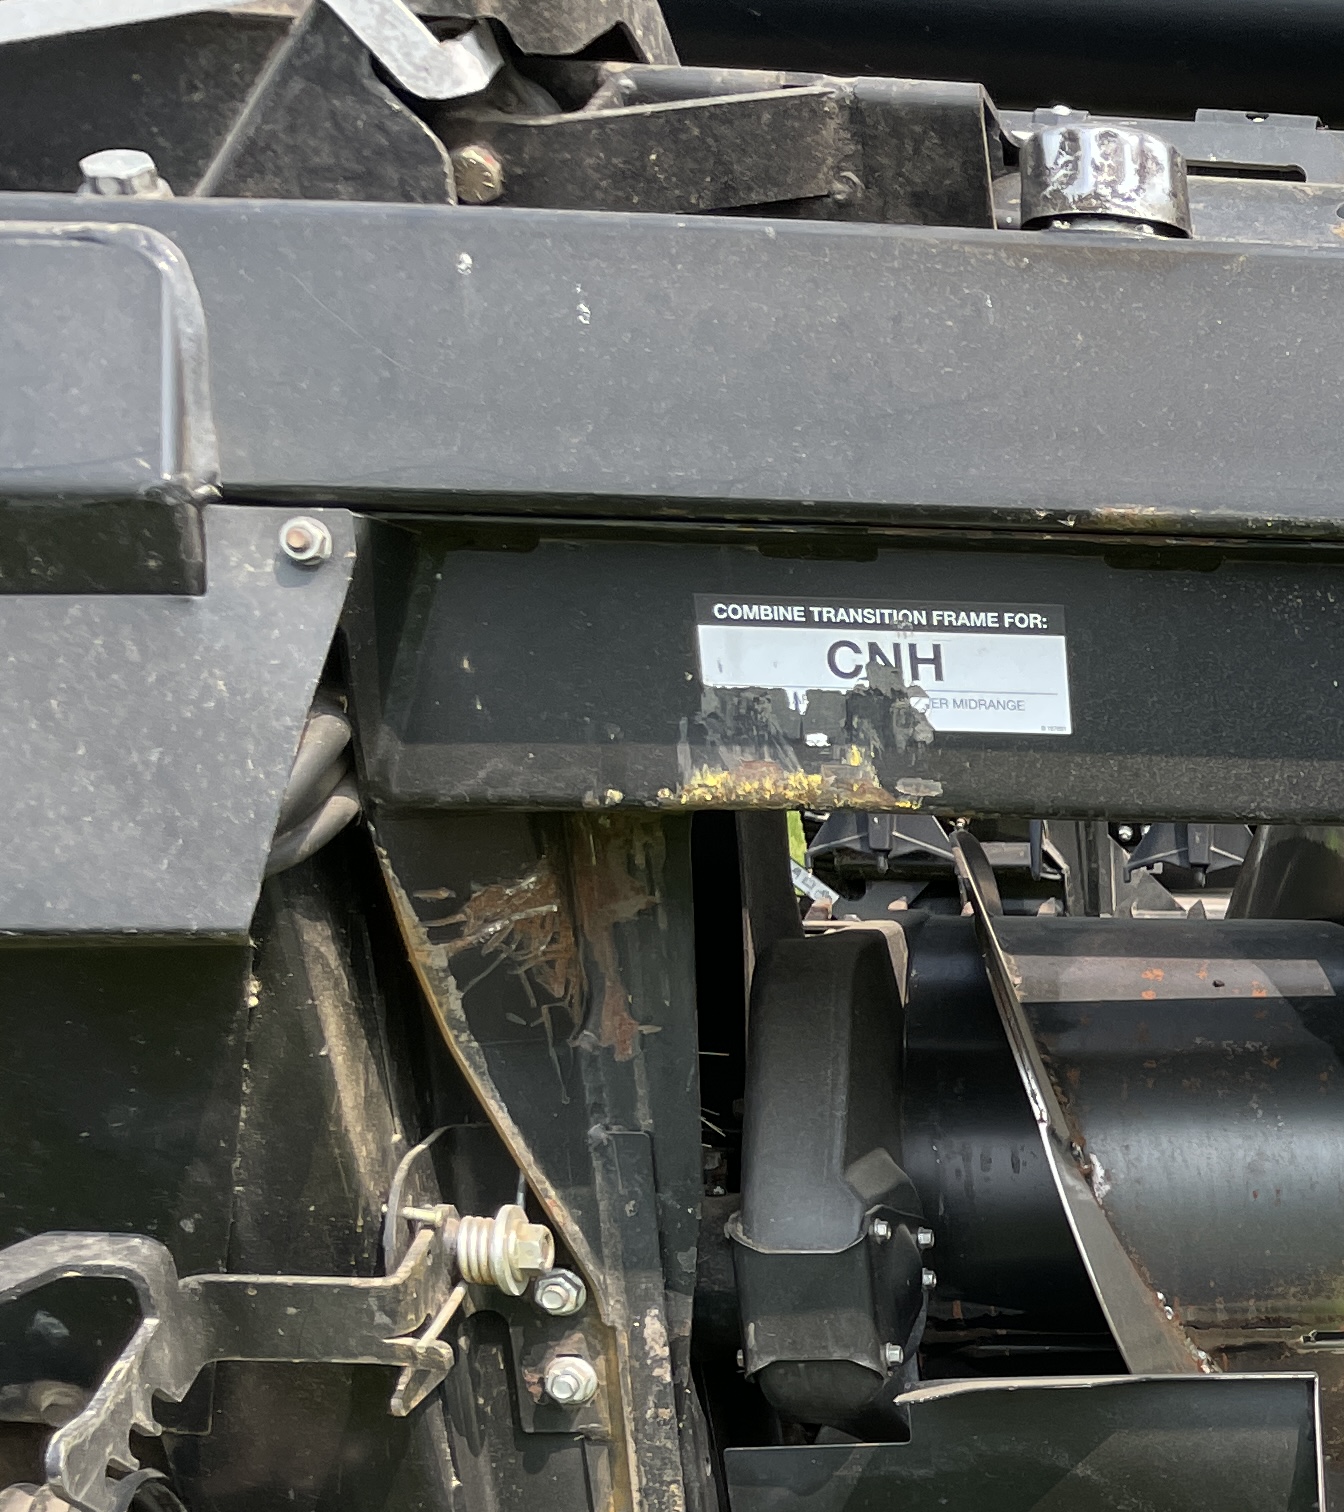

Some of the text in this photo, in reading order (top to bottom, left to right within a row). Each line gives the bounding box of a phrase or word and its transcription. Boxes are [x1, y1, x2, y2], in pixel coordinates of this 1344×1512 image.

[713, 603, 1048, 629] COMBINE TRANSITION FRAME FOR:
[827, 640, 945, 682] CNH
[952, 698, 1025, 711] MIDRANGE
